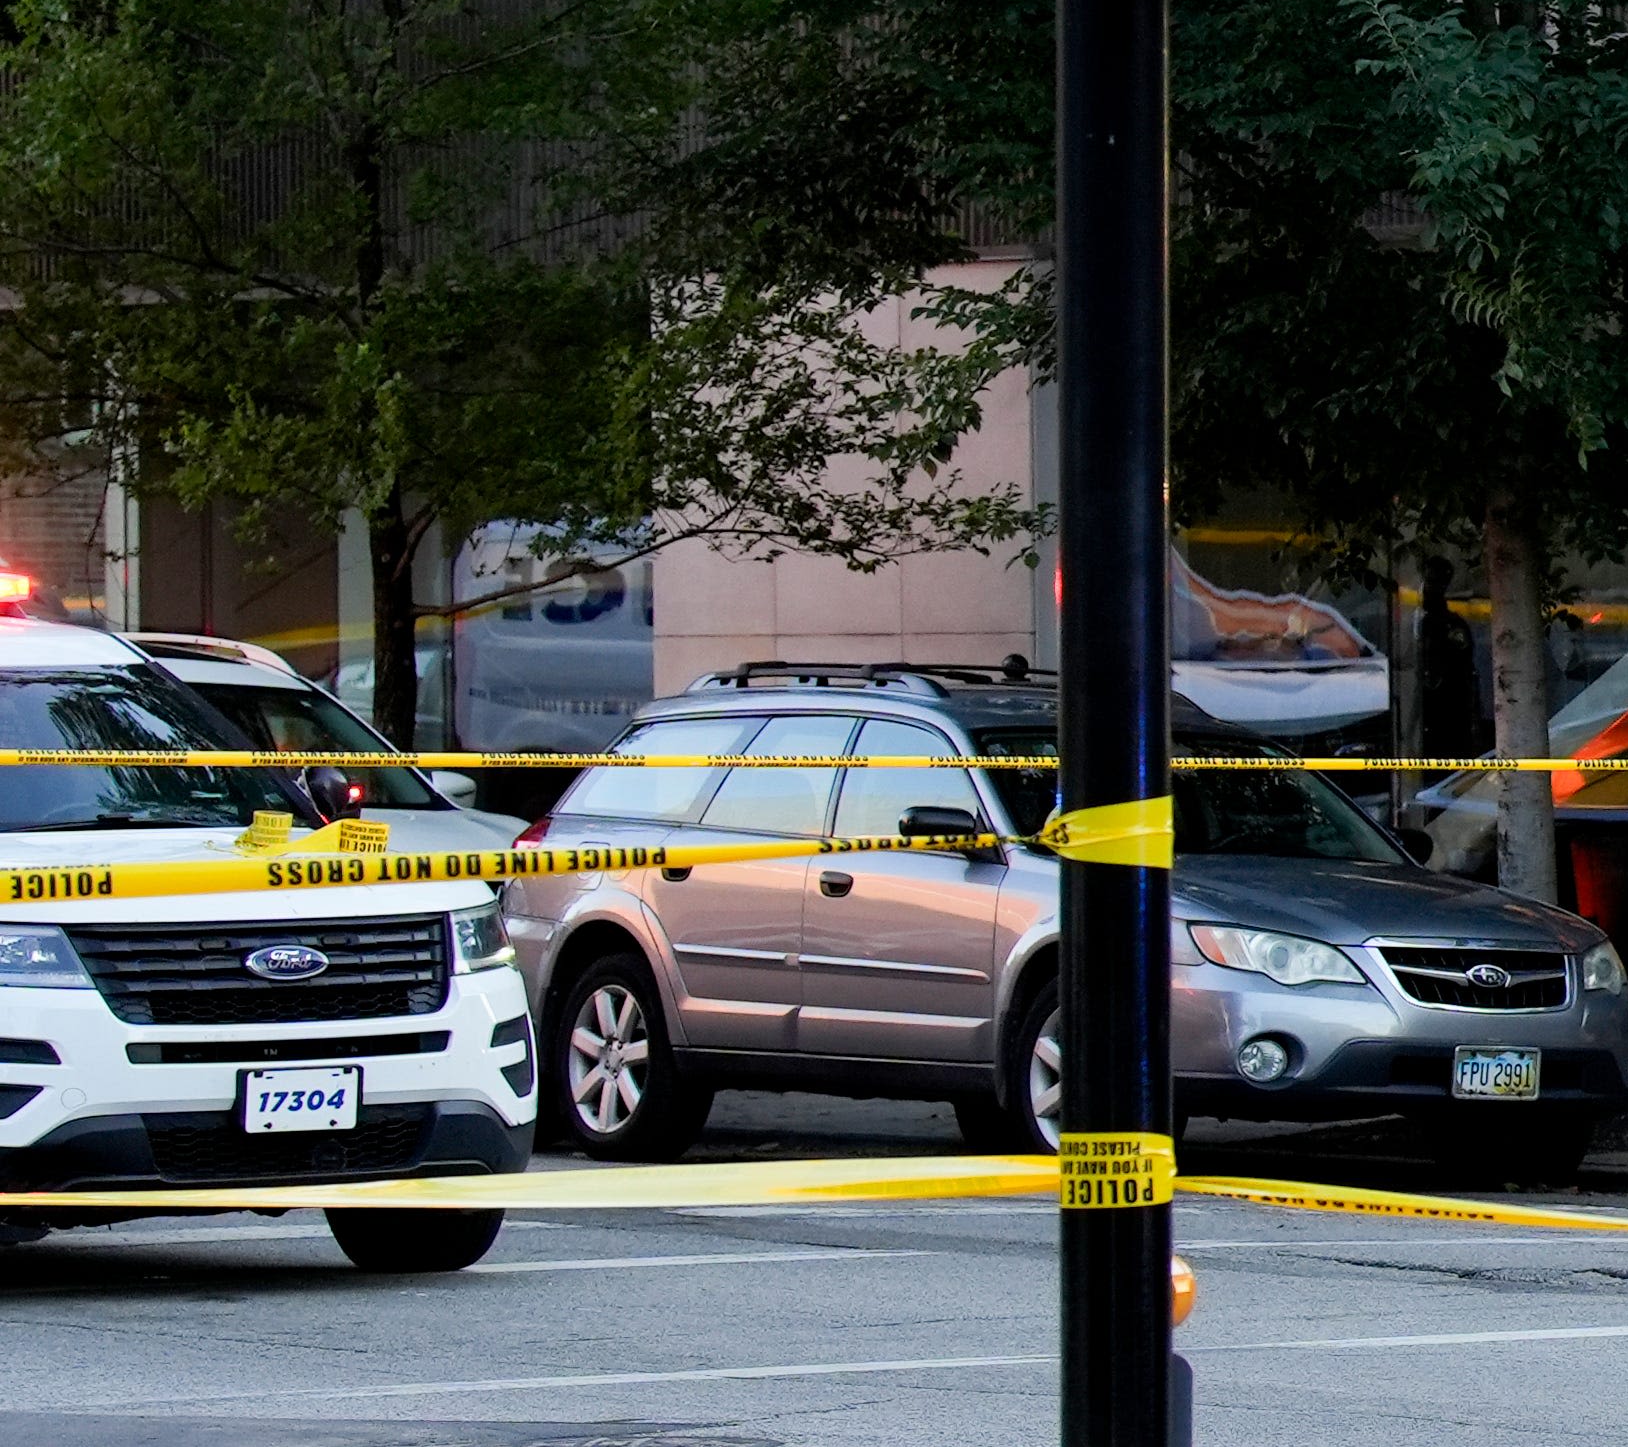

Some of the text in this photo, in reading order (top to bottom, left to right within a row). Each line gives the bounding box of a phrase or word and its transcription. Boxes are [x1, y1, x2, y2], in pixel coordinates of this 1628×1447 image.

[266, 846, 666, 887] POLICE LINE DO NOT CROSS
[10, 871, 113, 900] POLICE
[266, 949, 313, 970] Ford
[1461, 1062, 1530, 1087] FPU 2991
[259, 1089, 345, 1112] 17304
[1092, 1142, 1140, 1156] PLEASE
[1076, 1159, 1152, 1175] IF YOU HAVE
[1068, 1178, 1153, 1205] POLICE
